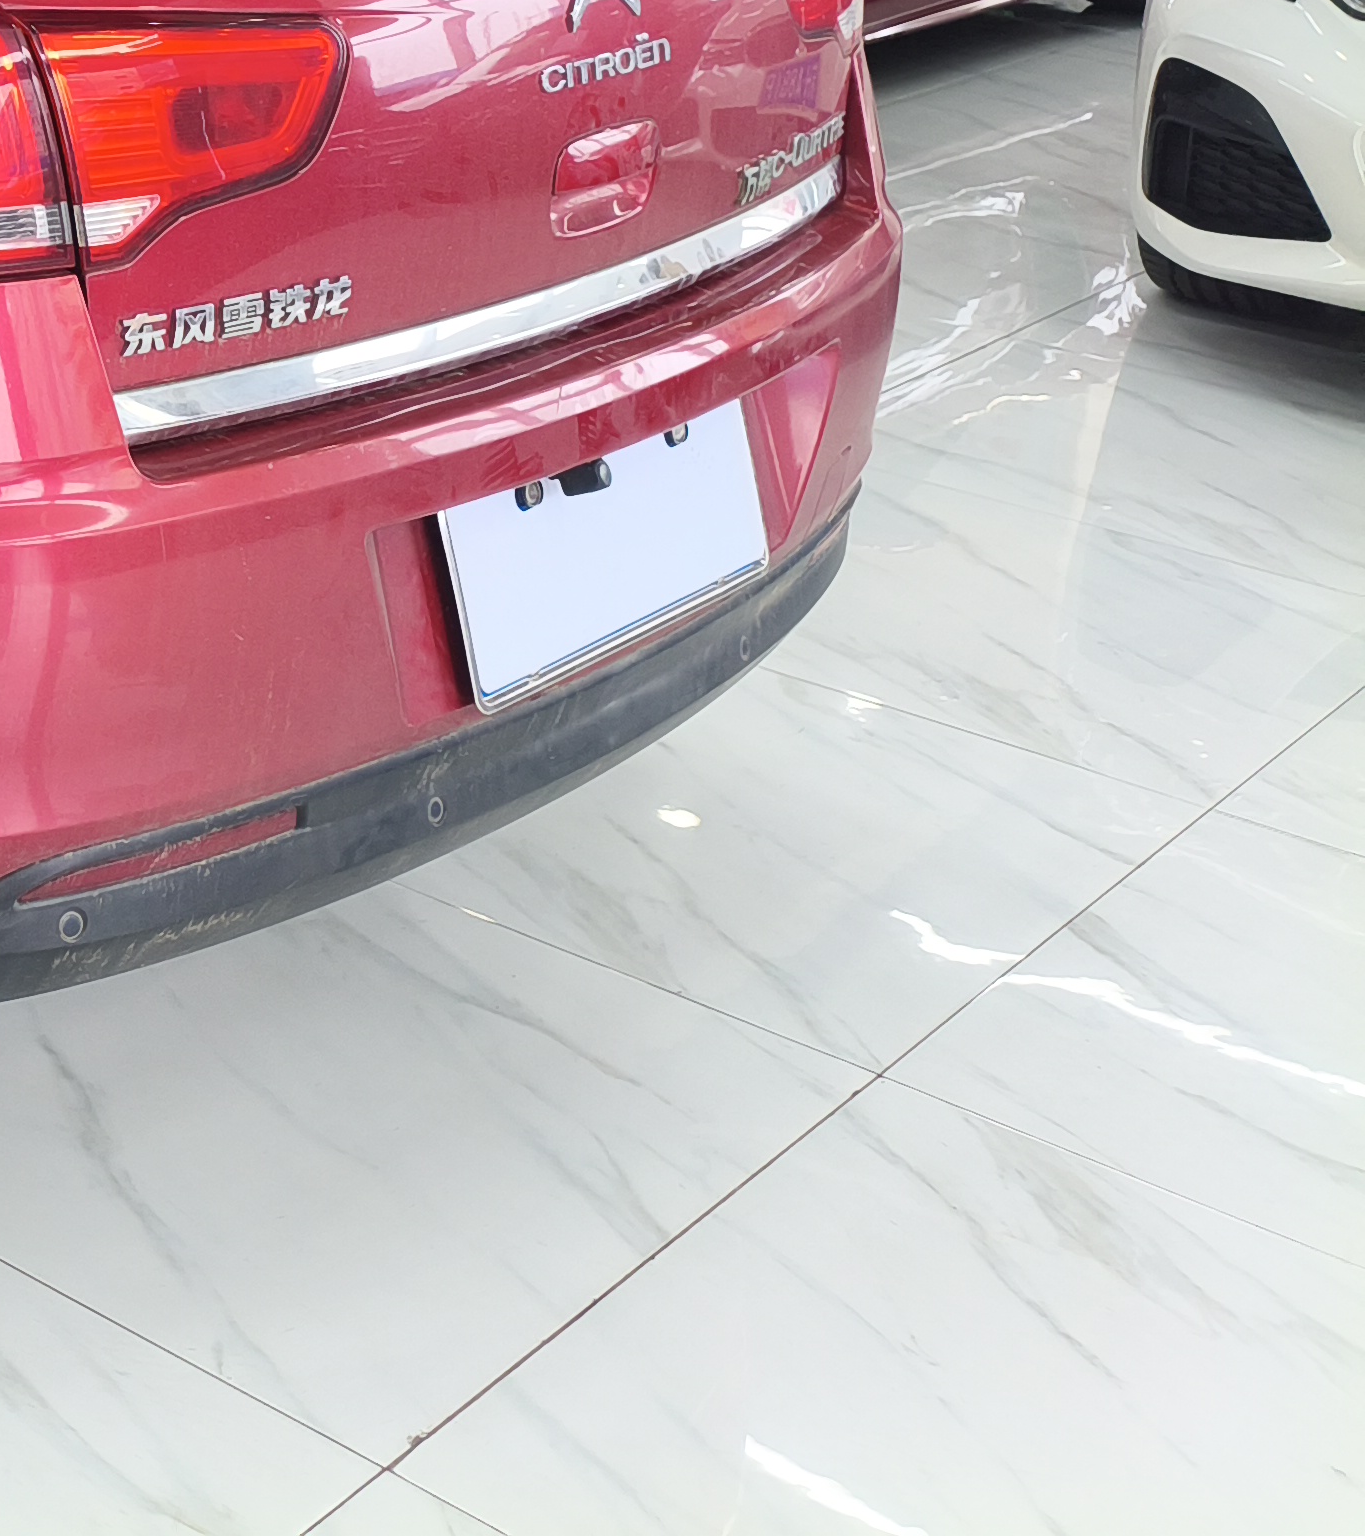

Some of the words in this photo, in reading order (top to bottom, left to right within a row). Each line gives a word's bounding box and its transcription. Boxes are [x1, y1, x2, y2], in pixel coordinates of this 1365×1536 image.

[121, 275, 353, 357] 东风雪铁龙
